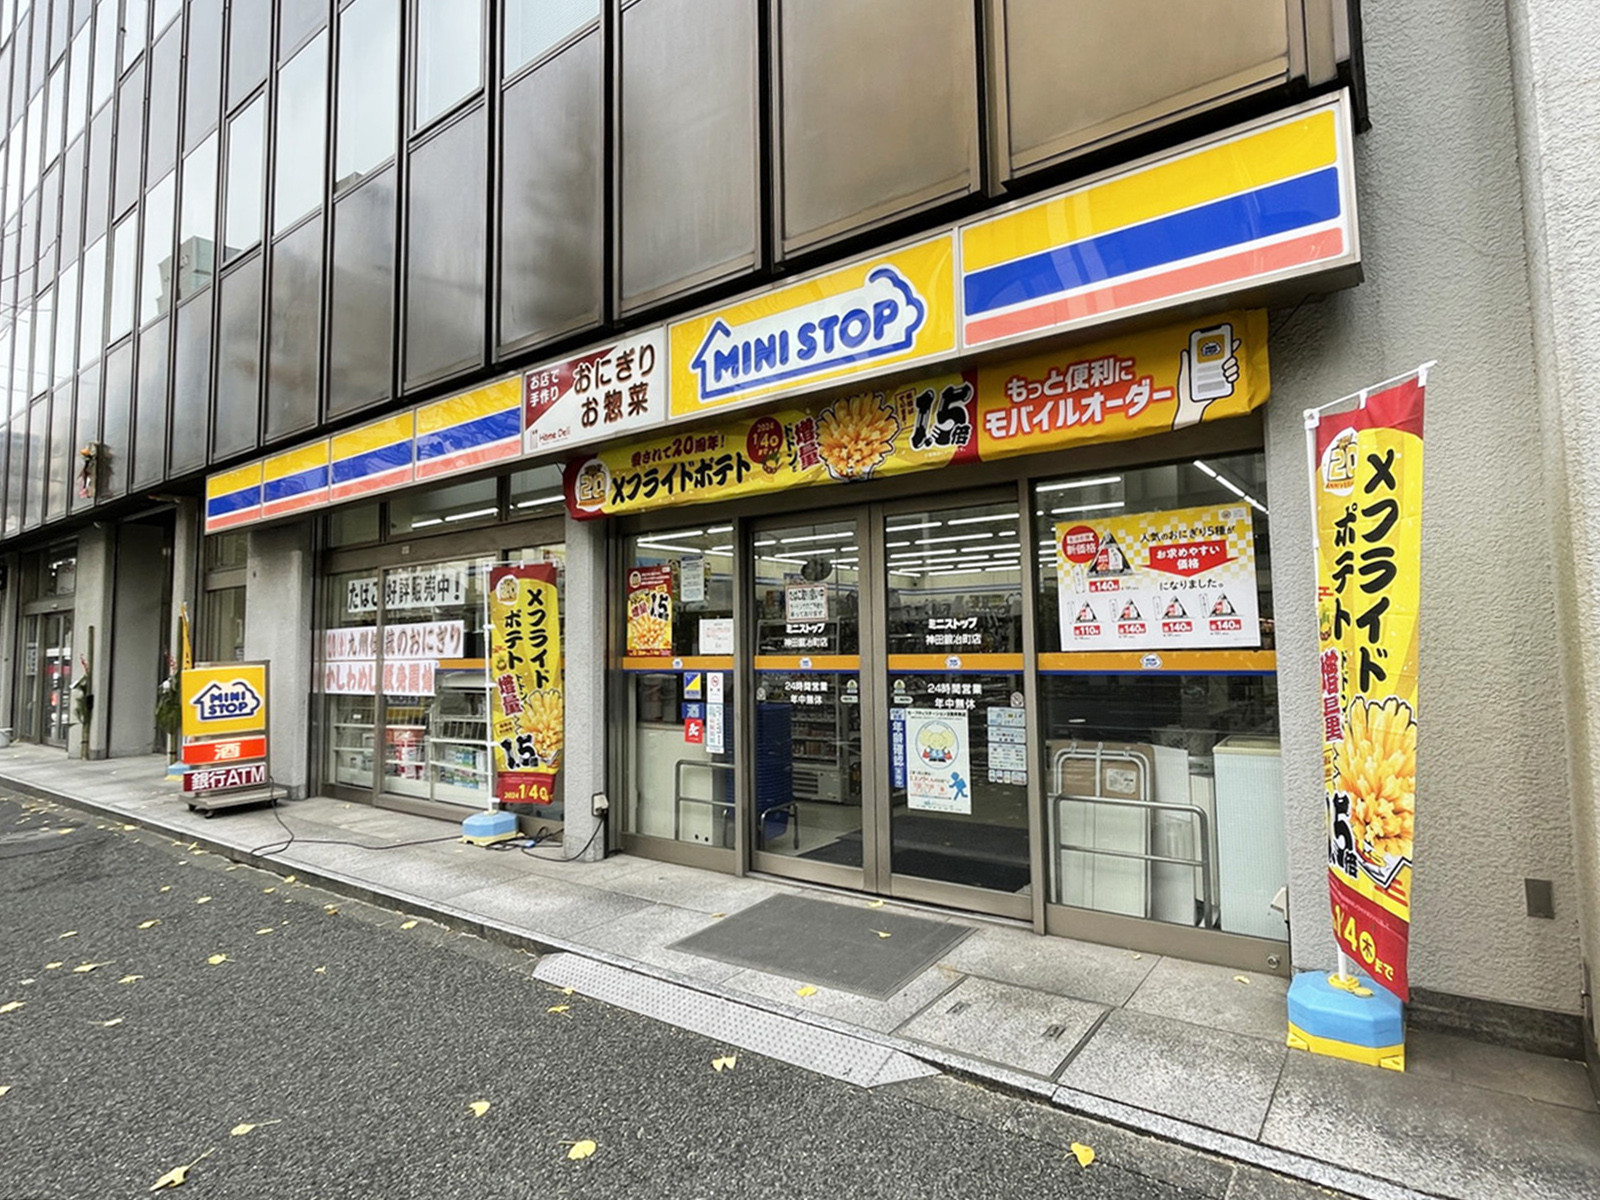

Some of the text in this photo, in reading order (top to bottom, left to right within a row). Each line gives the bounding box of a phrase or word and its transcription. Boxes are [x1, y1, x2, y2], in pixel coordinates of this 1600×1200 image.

[713, 299, 900, 383] MINI STOP
[574, 343, 656, 395] おにぎり
[529, 369, 560, 391] お店で
[1007, 356, 1134, 402] もっと便利に
[529, 386, 560, 408] 手作り
[581, 381, 649, 429] お惣菜
[985, 379, 1173, 438] モバイルオーダー
[1140, 525, 1236, 544] 人気のおにぎり5種が
[1156, 545, 1221, 560] お求めやすい
[1177, 558, 1200, 571] 価格
[1332, 502, 1359, 641] ポテト
[1159, 578, 1225, 591] になりました。
[786, 623, 826, 634] ミニストップ
[927, 617, 978, 630] ミニストップ
[504, 609, 524, 670] ポテト
[784, 681, 829, 692] 24時間営業
[926, 683, 982, 695] 24時間営業
[209, 690, 247, 704] MINI
[789, 694, 823, 705] 年中無休
[934, 698, 977, 710] 年中無休
[208, 701, 248, 716] STOP
[214, 742, 242, 761] 酒
[191, 765, 266, 791] 銀行ATM
